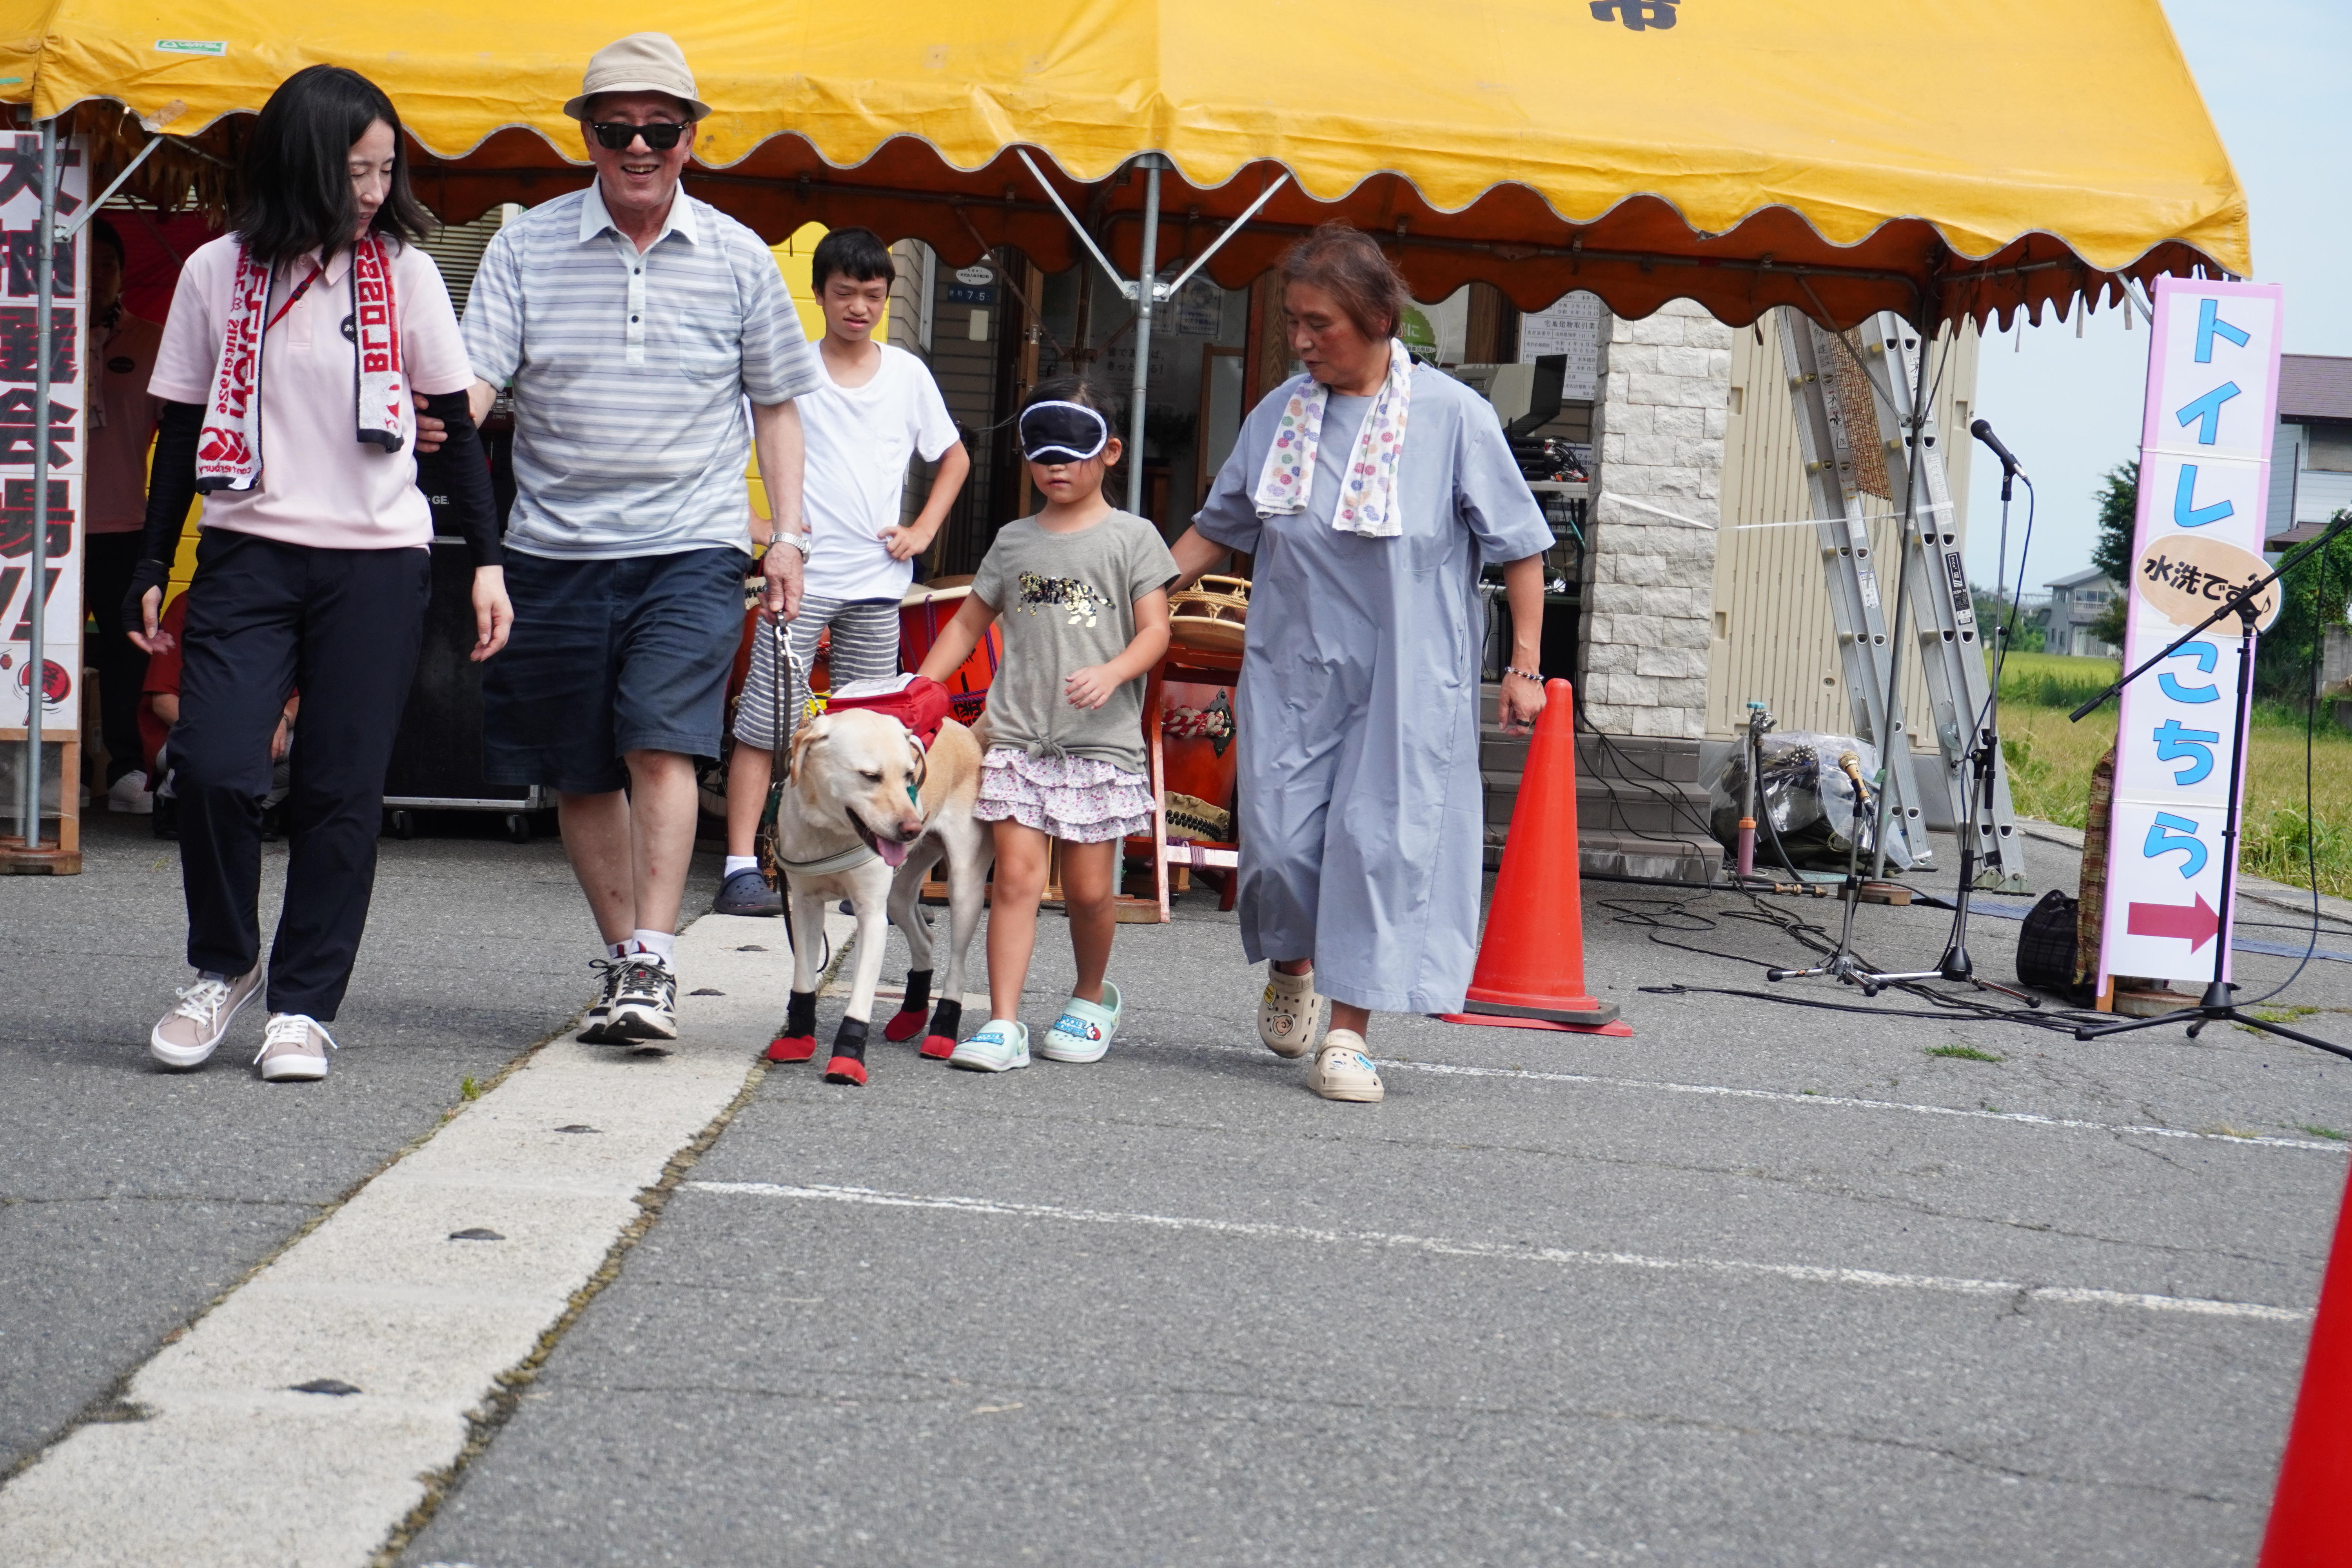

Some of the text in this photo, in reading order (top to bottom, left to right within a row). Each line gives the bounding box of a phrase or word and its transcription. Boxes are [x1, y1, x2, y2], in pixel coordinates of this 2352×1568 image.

[1544, 319, 1600, 330] 宅地建物取引業
[2173, 299, 2250, 528] トイレ
[2142, 641, 2220, 879] こちら
